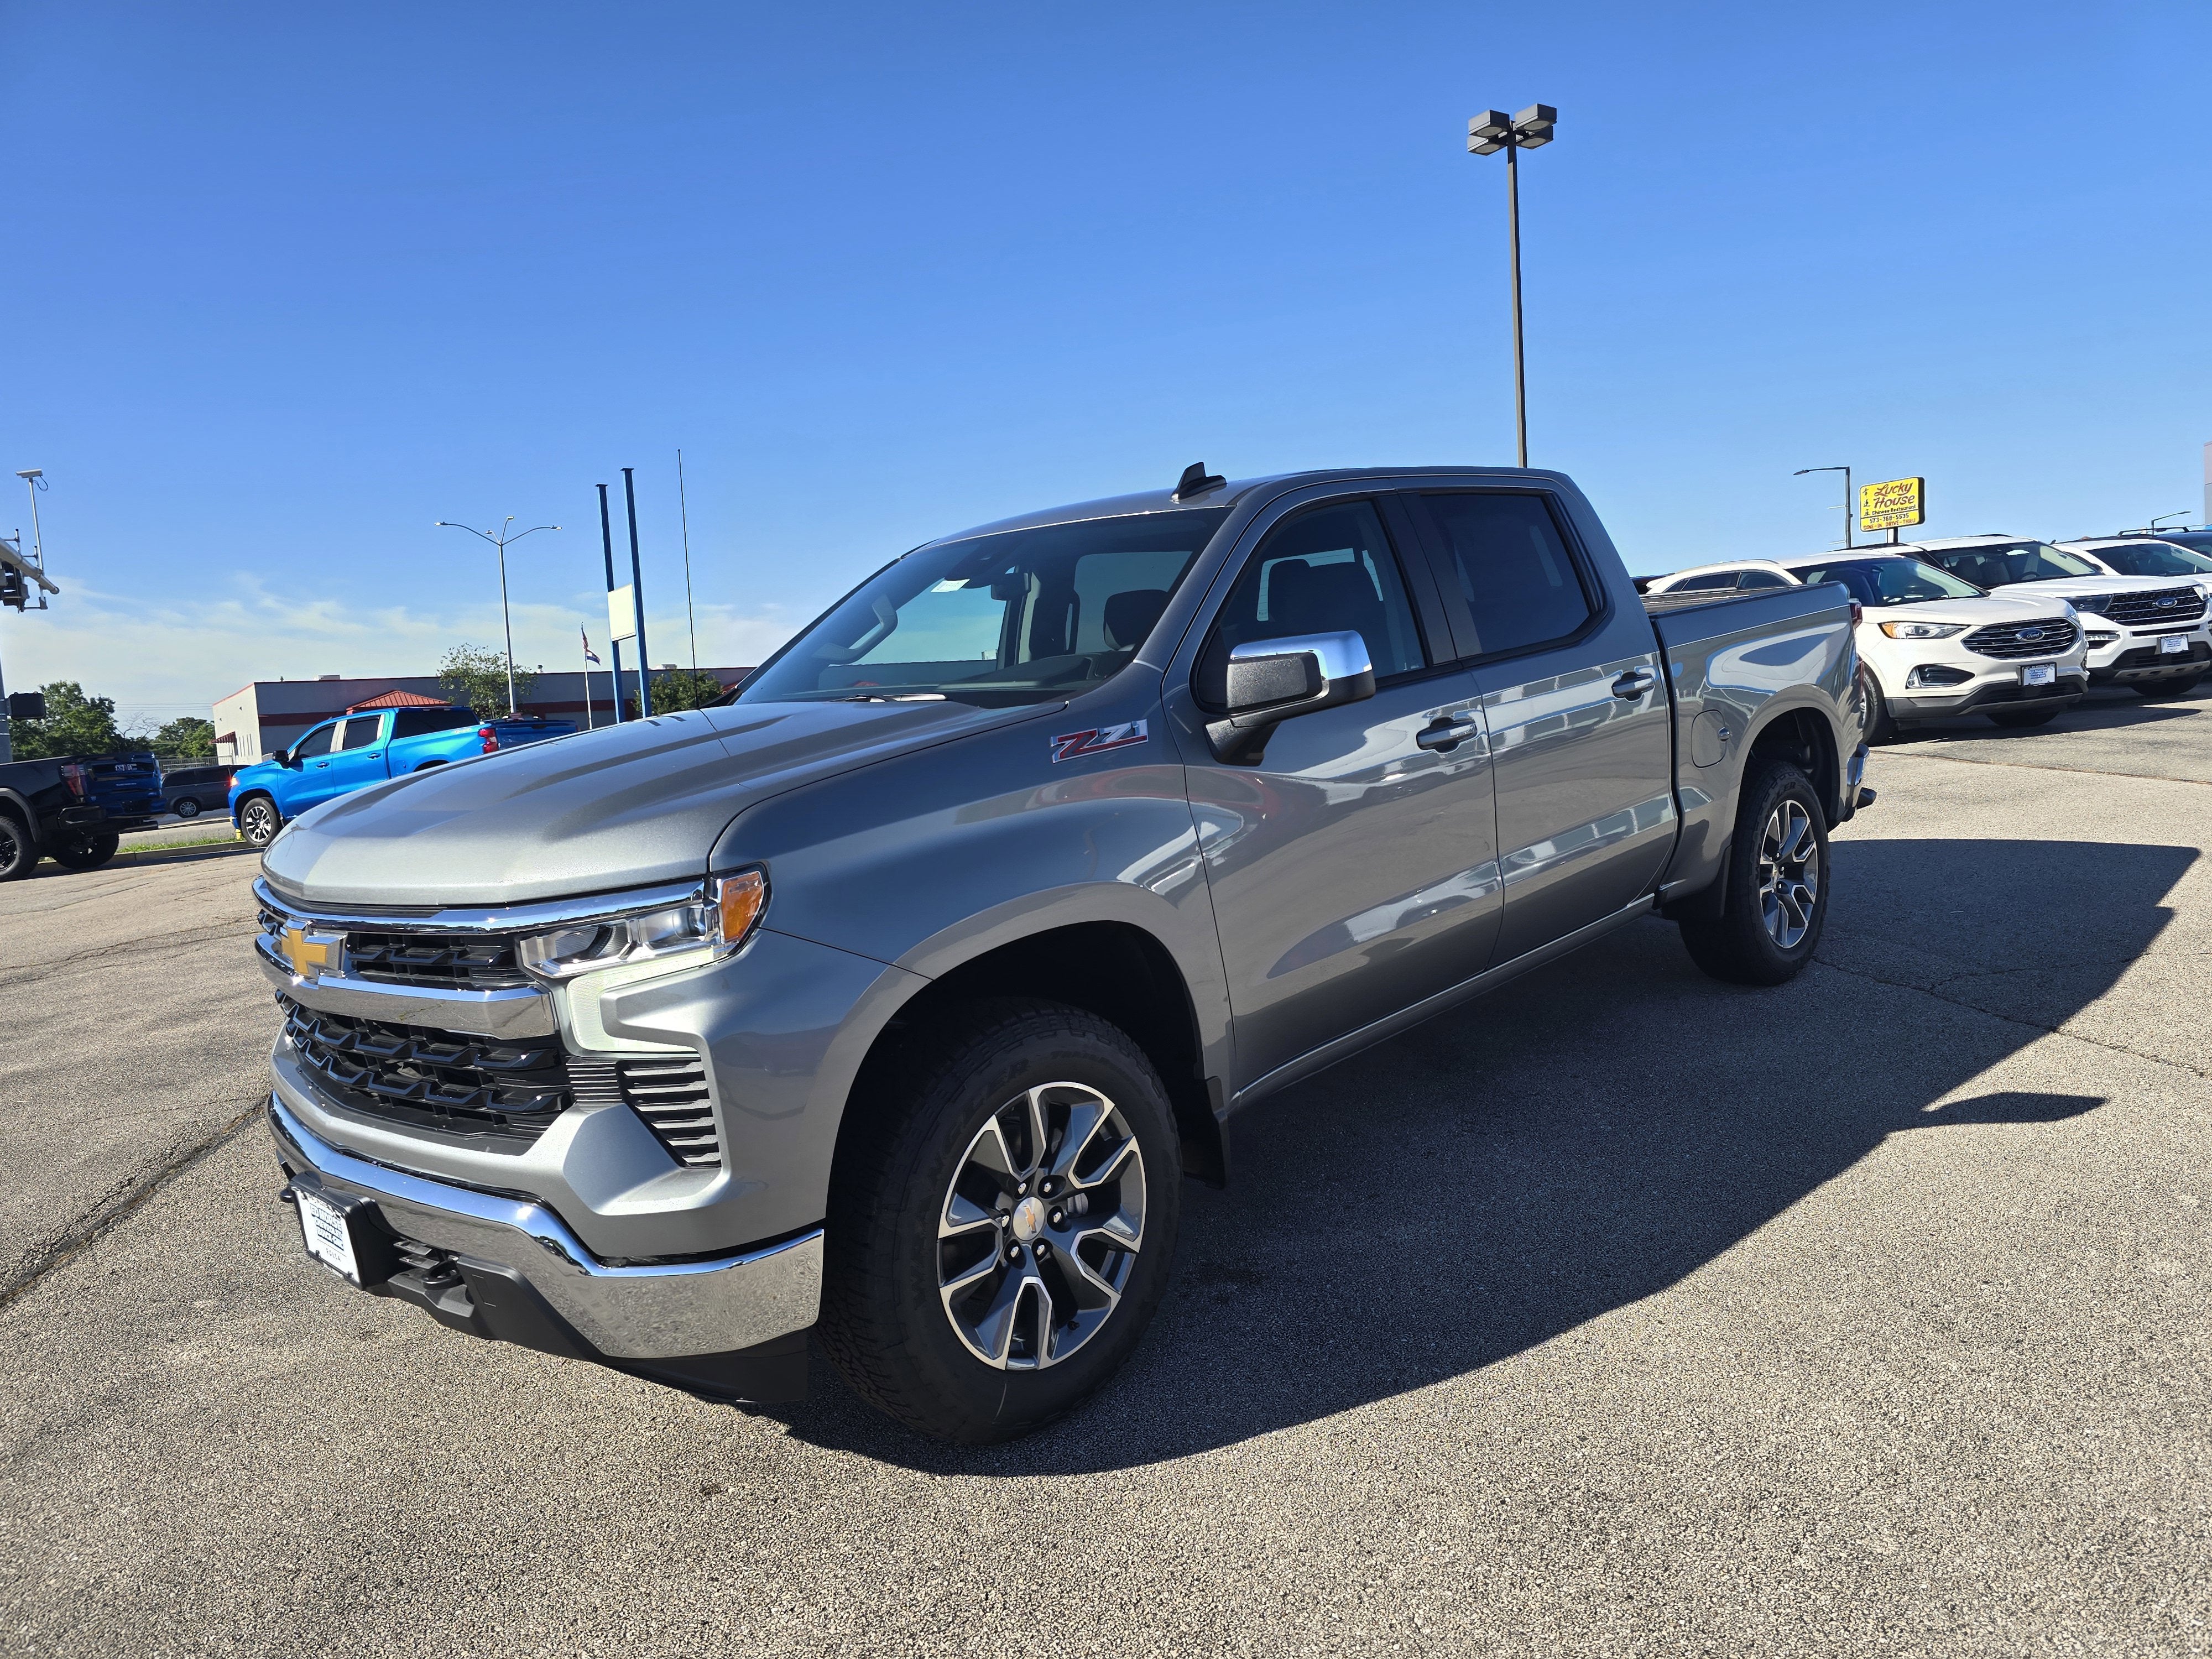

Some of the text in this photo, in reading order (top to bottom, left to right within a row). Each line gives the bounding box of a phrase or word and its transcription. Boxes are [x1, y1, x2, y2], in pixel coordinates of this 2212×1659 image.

[1874, 482, 1913, 497] Lucky
[1874, 495, 1915, 509] House
[1890, 504, 1916, 513] Restaurant
[1870, 513, 1909, 524] 573-368-5535
[1885, 518, 1916, 527] DRIVE-THRU
[1050, 718, 1149, 764] Z71
[309, 1203, 342, 1233] ED MORSE
